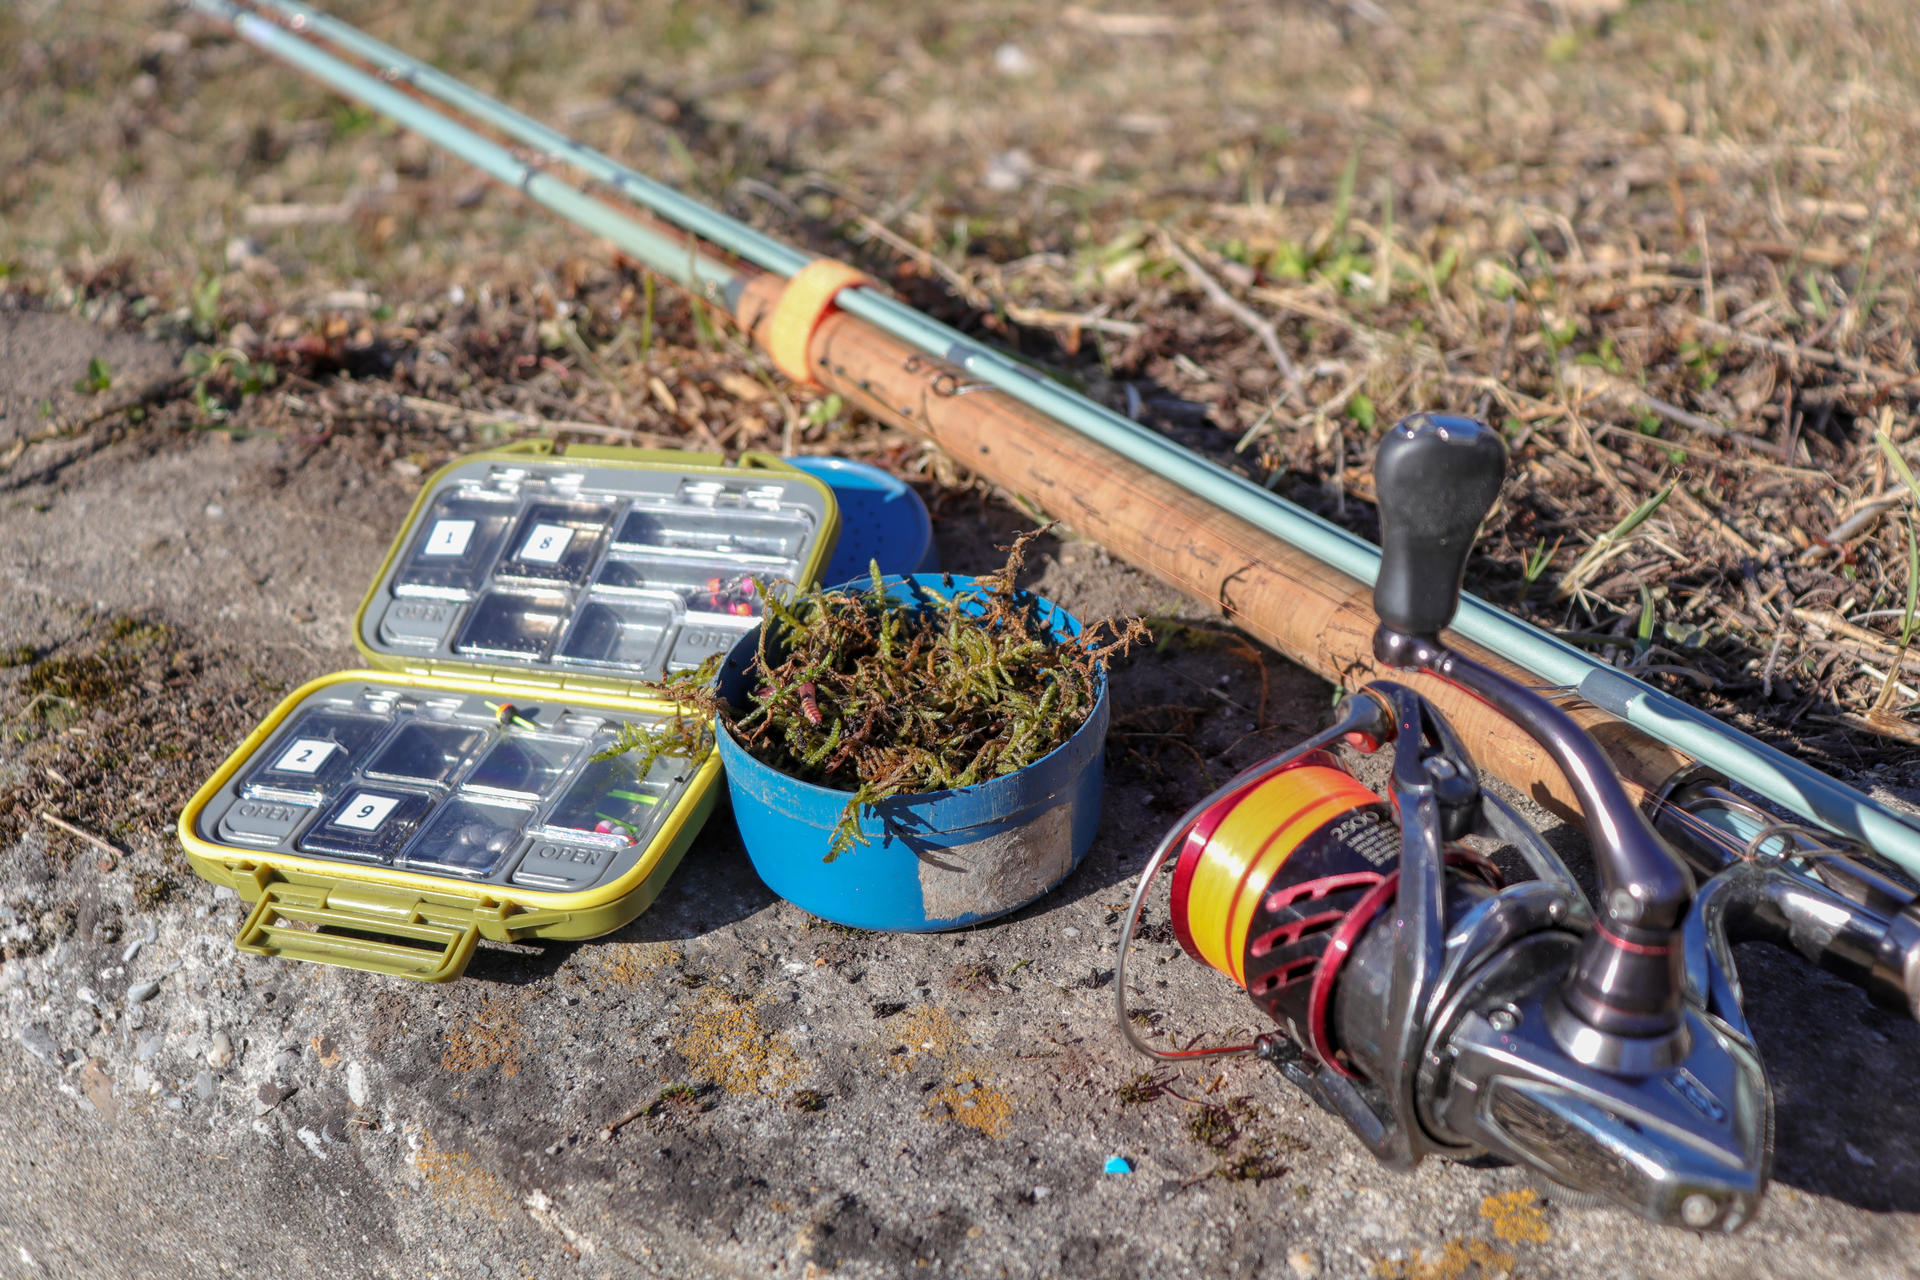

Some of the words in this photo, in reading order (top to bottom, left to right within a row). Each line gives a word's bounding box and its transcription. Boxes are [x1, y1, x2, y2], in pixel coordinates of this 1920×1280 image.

[445, 531, 453, 544] 1
[539, 536, 553, 549] 8
[296, 749, 313, 763] 2
[239, 803, 296, 822] OPEN
[356, 805, 375, 818] 9
[1329, 811, 1380, 841] 2500
[539, 845, 602, 865] OPEN
